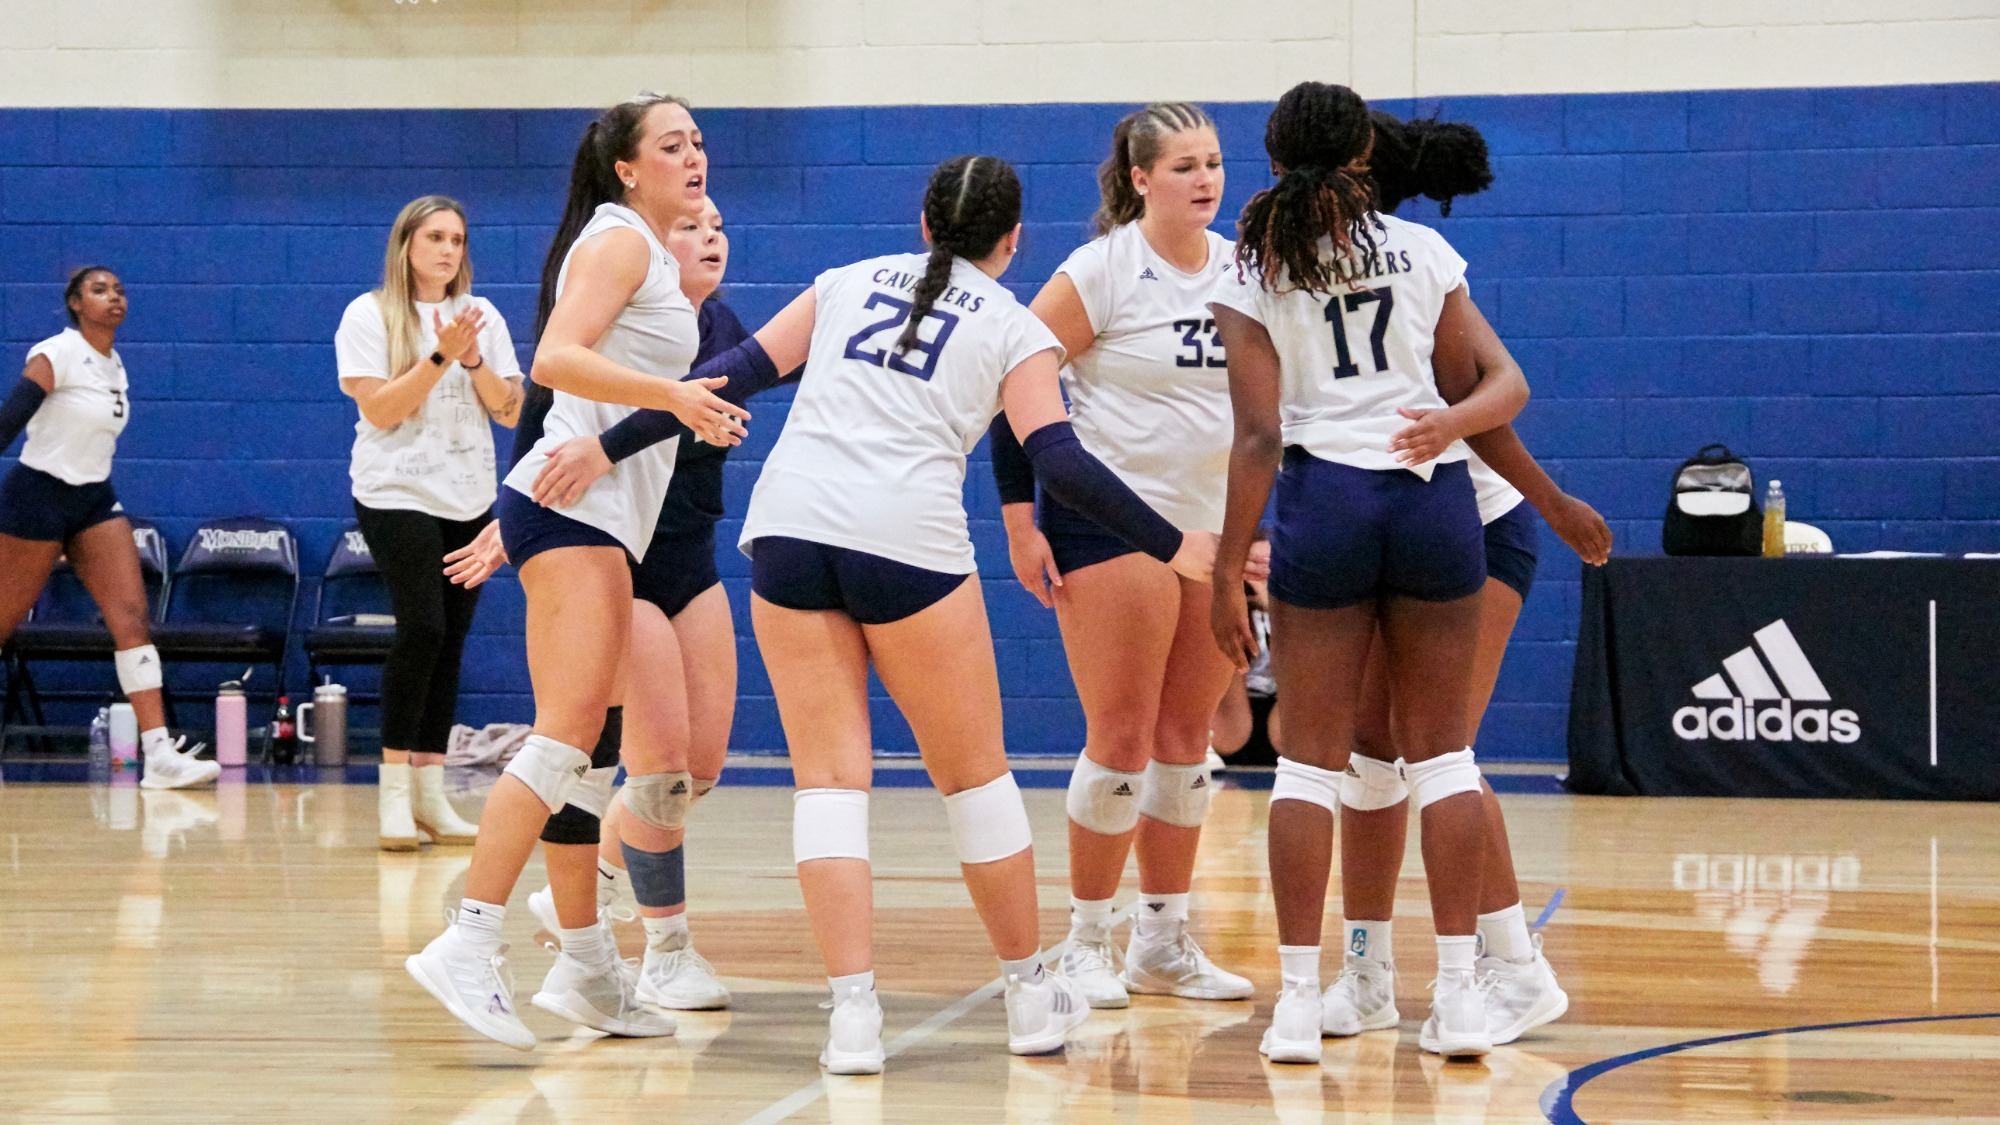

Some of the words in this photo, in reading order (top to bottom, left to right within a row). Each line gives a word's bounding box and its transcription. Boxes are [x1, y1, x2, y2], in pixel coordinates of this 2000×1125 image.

[873, 268, 985, 313] CAVAERS
[843, 291, 960, 382] 29
[1173, 318, 1228, 368] 33
[1324, 286, 1394, 380] 17
[109, 389, 124, 418] 3
[1672, 696, 1861, 743] adidas
